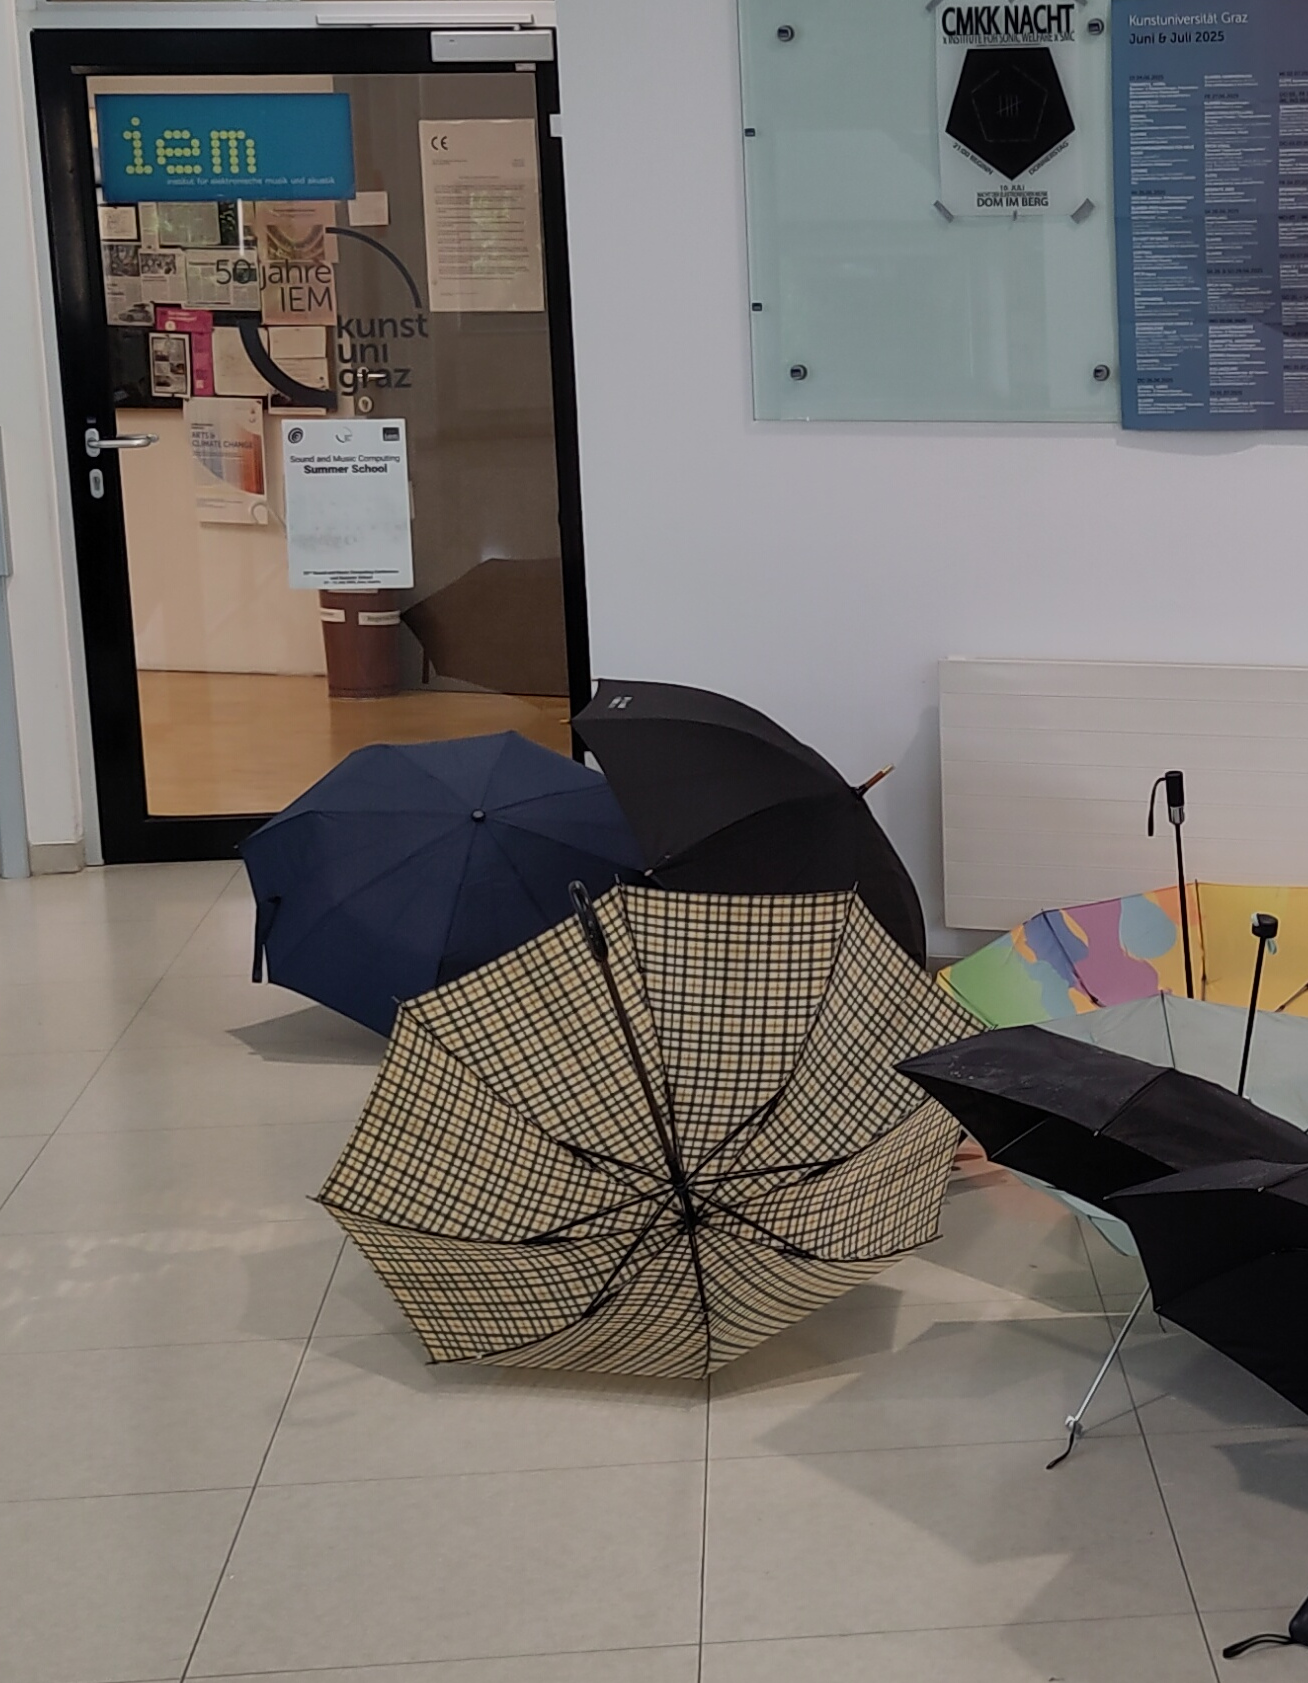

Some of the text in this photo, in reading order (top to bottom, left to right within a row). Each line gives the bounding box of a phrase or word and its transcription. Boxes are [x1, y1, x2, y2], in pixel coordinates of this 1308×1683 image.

[942, 3, 1075, 36] CMKK NACHT
[1129, 11, 1249, 27] Kunstuniversität Graz
[1129, 30, 1225, 45] Juni & Juli 2025
[123, 116, 256, 174] iem
[431, 135, 449, 151] CE
[264, 176, 288, 185] musik
[291, 176, 305, 185] und
[977, 197, 1049, 208] DOM IM BERG
[215, 258, 332, 291] 50 jahre
[280, 286, 333, 313] IEM
[337, 313, 429, 339] kunst
[337, 343, 389, 363] uni
[339, 367, 412, 396] graz
[290, 454, 401, 463] Sound and Music Computing
[303, 463, 388, 474] Summer School
